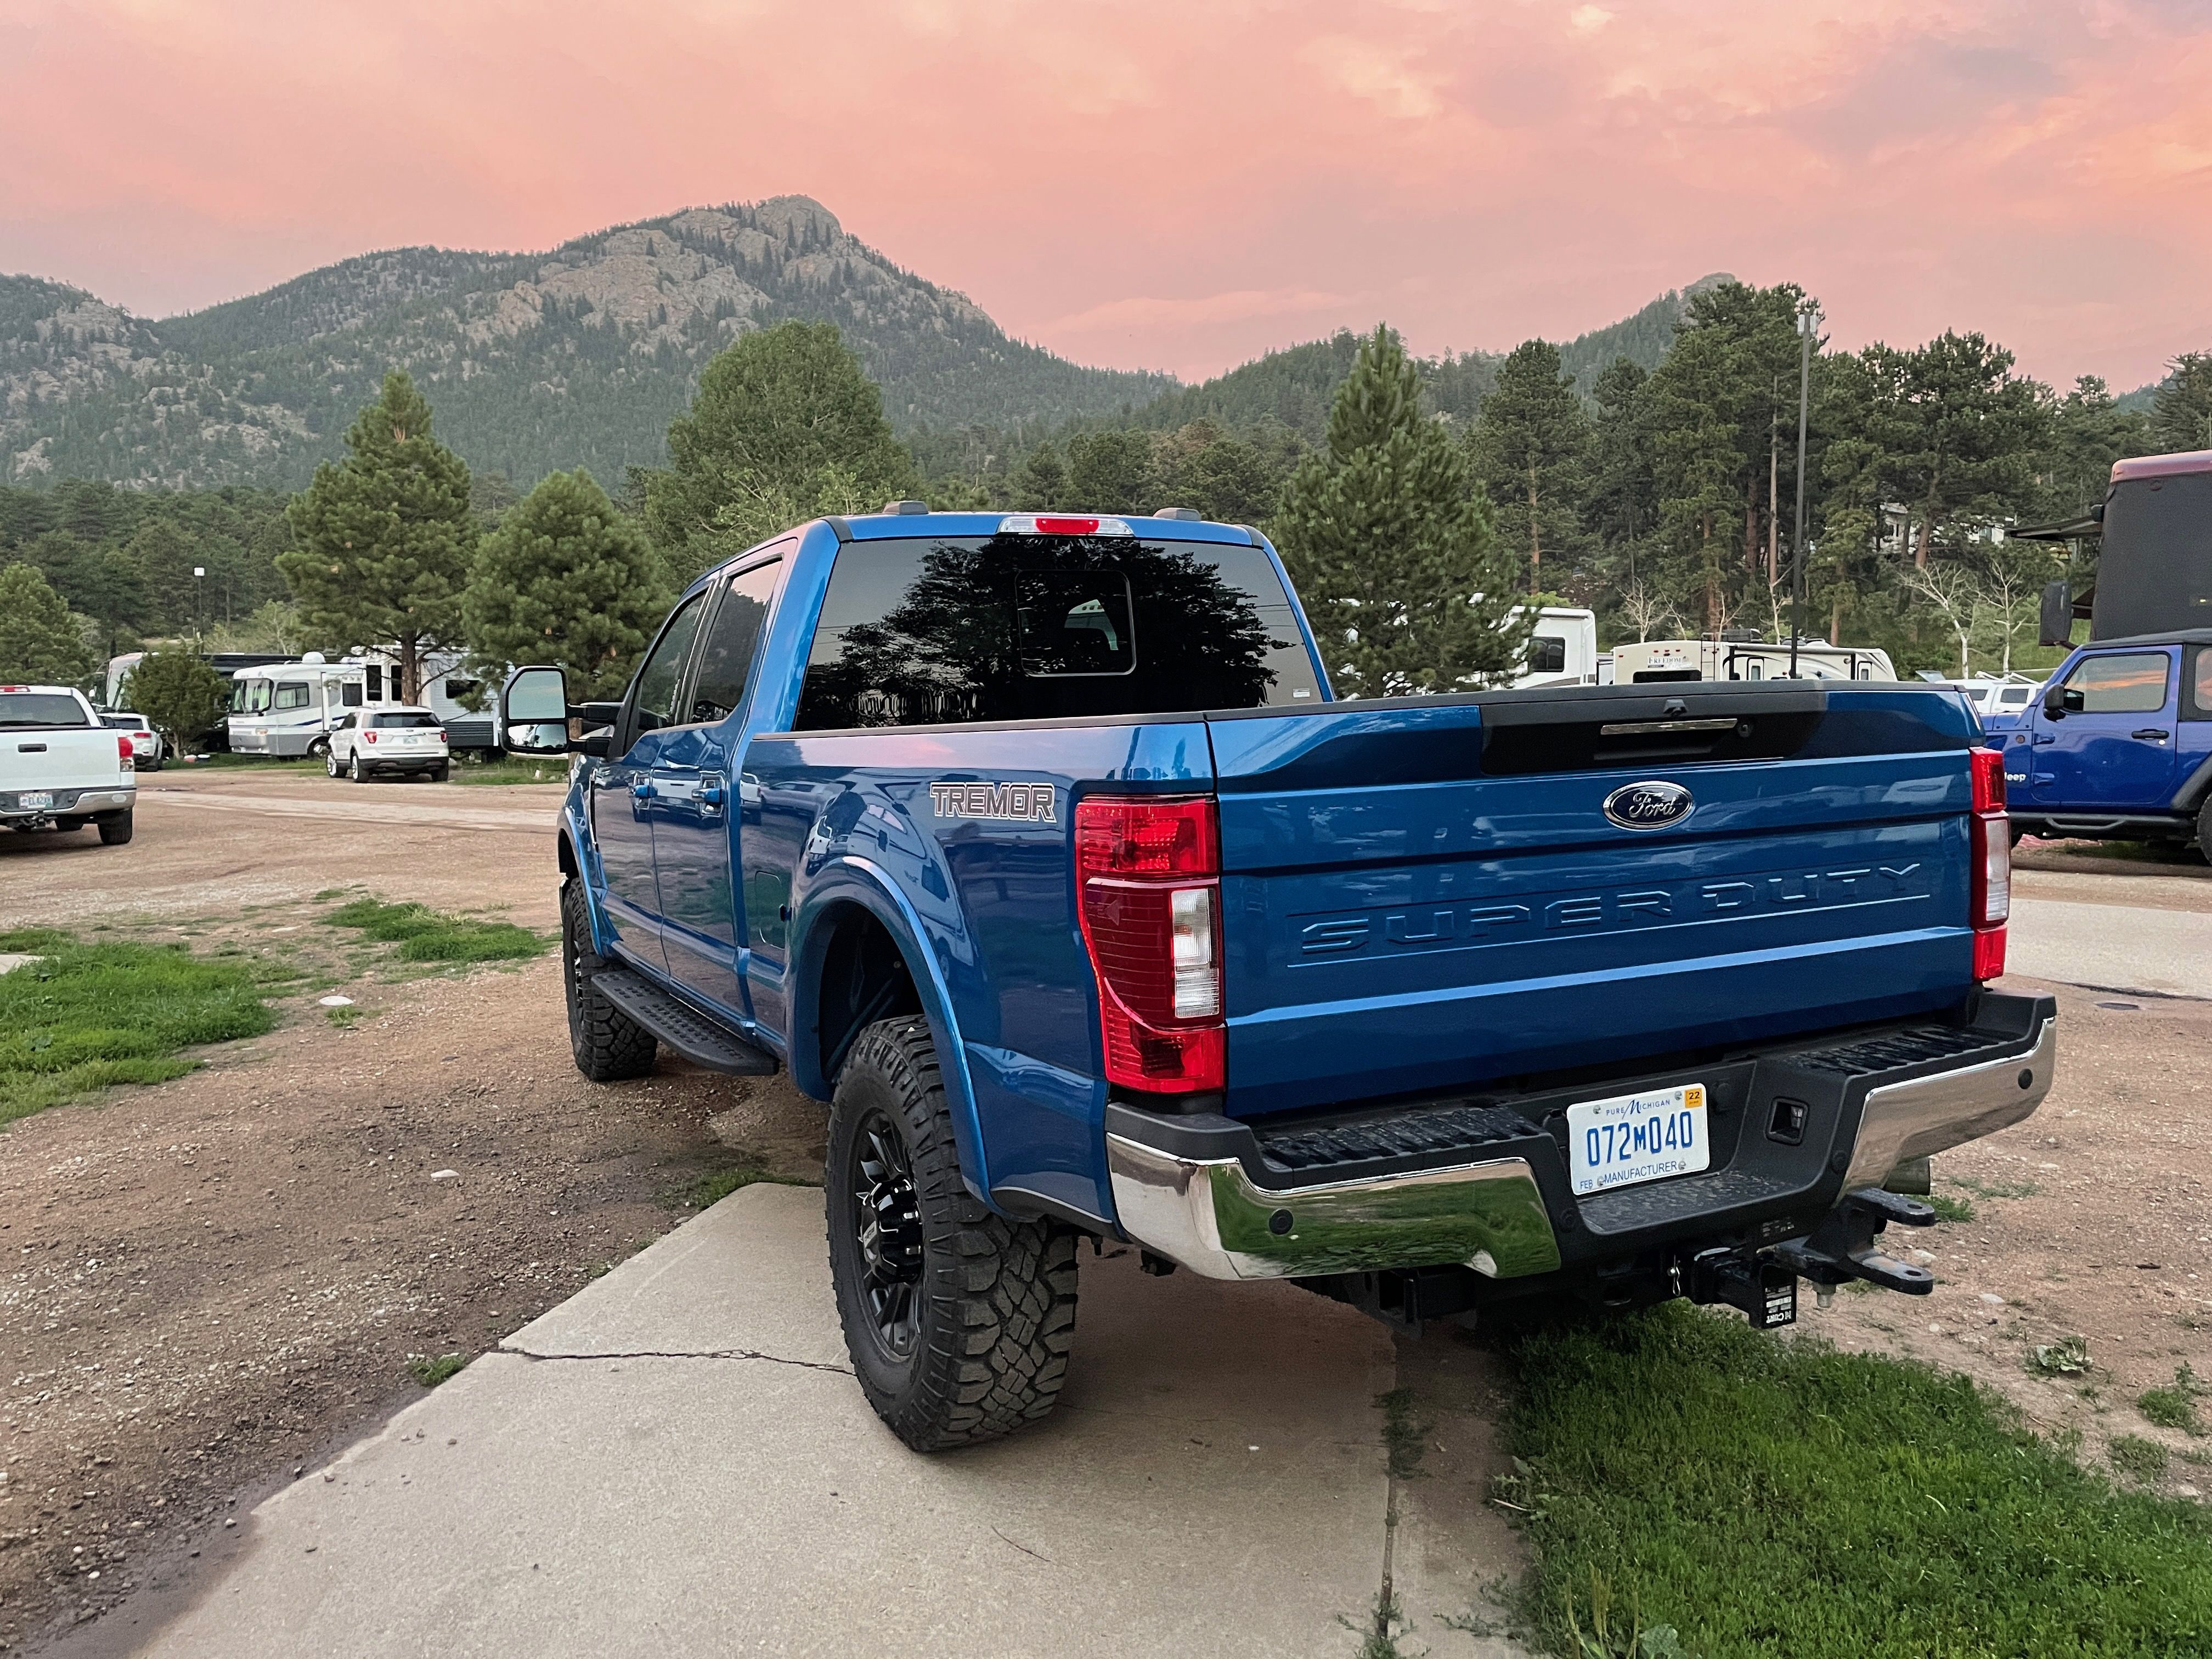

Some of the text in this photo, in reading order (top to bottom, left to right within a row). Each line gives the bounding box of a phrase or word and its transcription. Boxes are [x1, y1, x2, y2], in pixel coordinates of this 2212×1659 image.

[930, 782, 1057, 823] TREMOR
[1629, 792, 1677, 818] Ford
[1302, 862, 1920, 955] SUPER DUTY
[1606, 1099, 1671, 1120] PURE MICHIGAN
[1689, 1091, 1700, 1100] 22
[1587, 1111, 1693, 1167] 072M040
[1580, 1161, 1677, 1190] FEB MANUFACTURER
